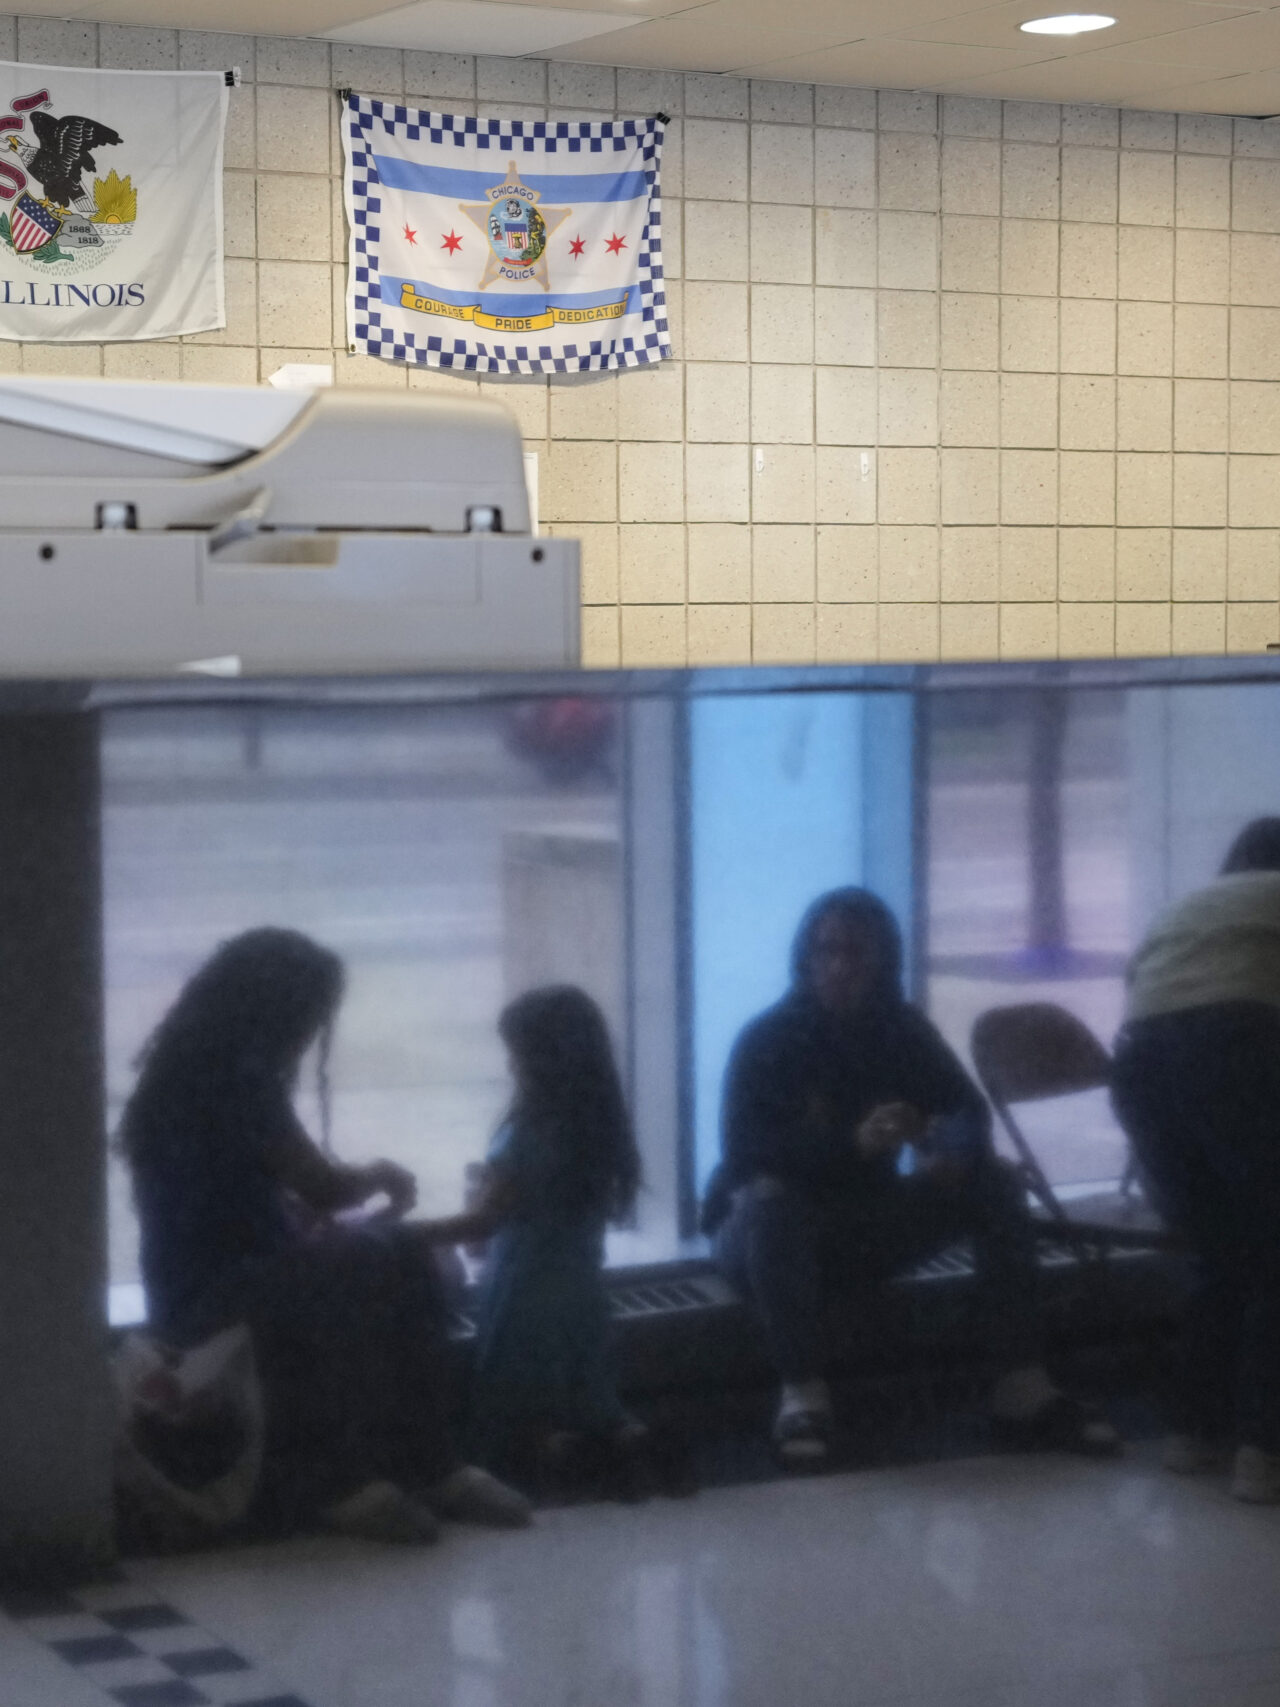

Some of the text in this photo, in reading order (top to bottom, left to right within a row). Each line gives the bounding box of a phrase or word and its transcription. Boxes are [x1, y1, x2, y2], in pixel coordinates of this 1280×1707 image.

[491, 185, 534, 201] CHICAGO
[78, 236, 99, 244] 1818
[499, 266, 536, 280] POLICE
[414, 298, 465, 319] COURAGE
[558, 304, 626, 322] DEDICATION
[495, 318, 532, 330] PRIDE
